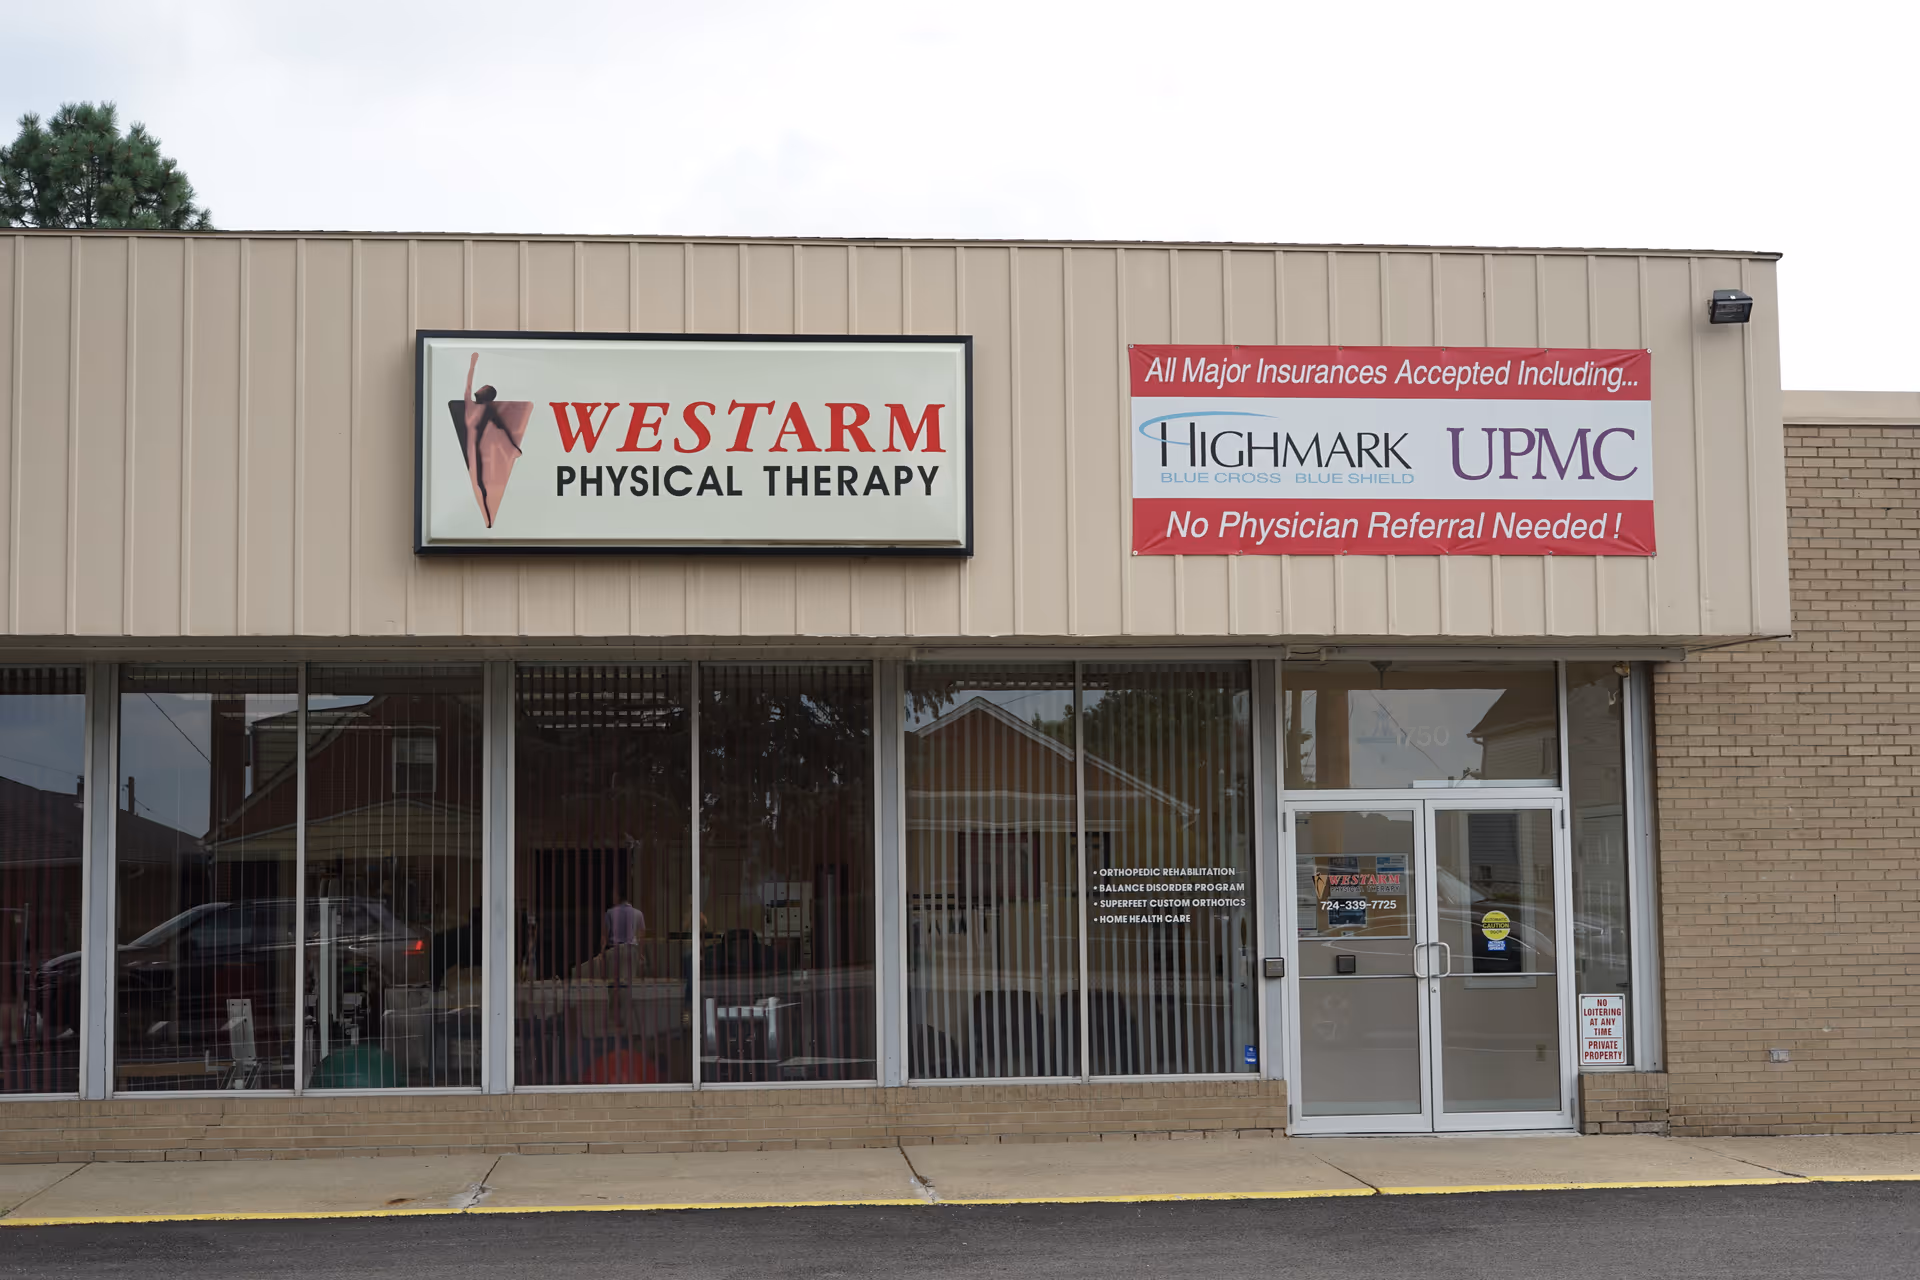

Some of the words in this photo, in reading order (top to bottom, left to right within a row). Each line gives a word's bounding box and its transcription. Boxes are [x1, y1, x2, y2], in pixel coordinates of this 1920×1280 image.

[1145, 357, 1177, 383] All
[1182, 357, 1251, 390] Major
[1256, 358, 1388, 384] Insurances
[1394, 359, 1511, 391] Accepted
[1517, 361, 1639, 393] Including...
[549, 399, 947, 454] WESTARM
[1160, 421, 1412, 470] HIGHMARK
[1446, 427, 1638, 481] UPMC
[556, 465, 743, 497] PHYSICAL
[763, 465, 940, 497] THERAPY
[1161, 472, 1209, 483] BLUE
[1214, 472, 1281, 484] CROSS
[1295, 473, 1343, 484] BLUE
[1347, 473, 1414, 485] SHIELD
[1166, 511, 1209, 538] No
[1218, 511, 1359, 545] Physician
[1367, 511, 1485, 539] Referral
[1492, 512, 1607, 539] Needed
[1099, 868, 1161, 877] ORTHOPEDIC
[1162, 867, 1236, 876] REHABILITATION
[1329, 874, 1400, 885] WESTARM
[1099, 884, 1145, 892] BALANCE
[1146, 883, 1193, 892] DISORDER
[1194, 883, 1245, 892] PROGRAM
[1331, 885, 1365, 893] PHYSICAL
[1367, 885, 1400, 893] THERAPY
[1100, 899, 1147, 908] SUPERFEET
[1149, 899, 1190, 907] CUSTOM
[1192, 898, 1246, 907] ORTHOTICS
[1320, 901, 1397, 910] 724-339-7725
[1099, 915, 1128, 924] HOME
[1129, 915, 1163, 923] HEALTH
[1165, 914, 1191, 923] CARE
[1583, 1008, 1621, 1016] LOITERING
[1590, 1018, 1598, 1026] AT
[1601, 1018, 1615, 1026] ANY
[1594, 1028, 1612, 1036] TIME
[1588, 1041, 1618, 1049] PRIVATE
[1584, 1051, 1622, 1060] PROPERTY
